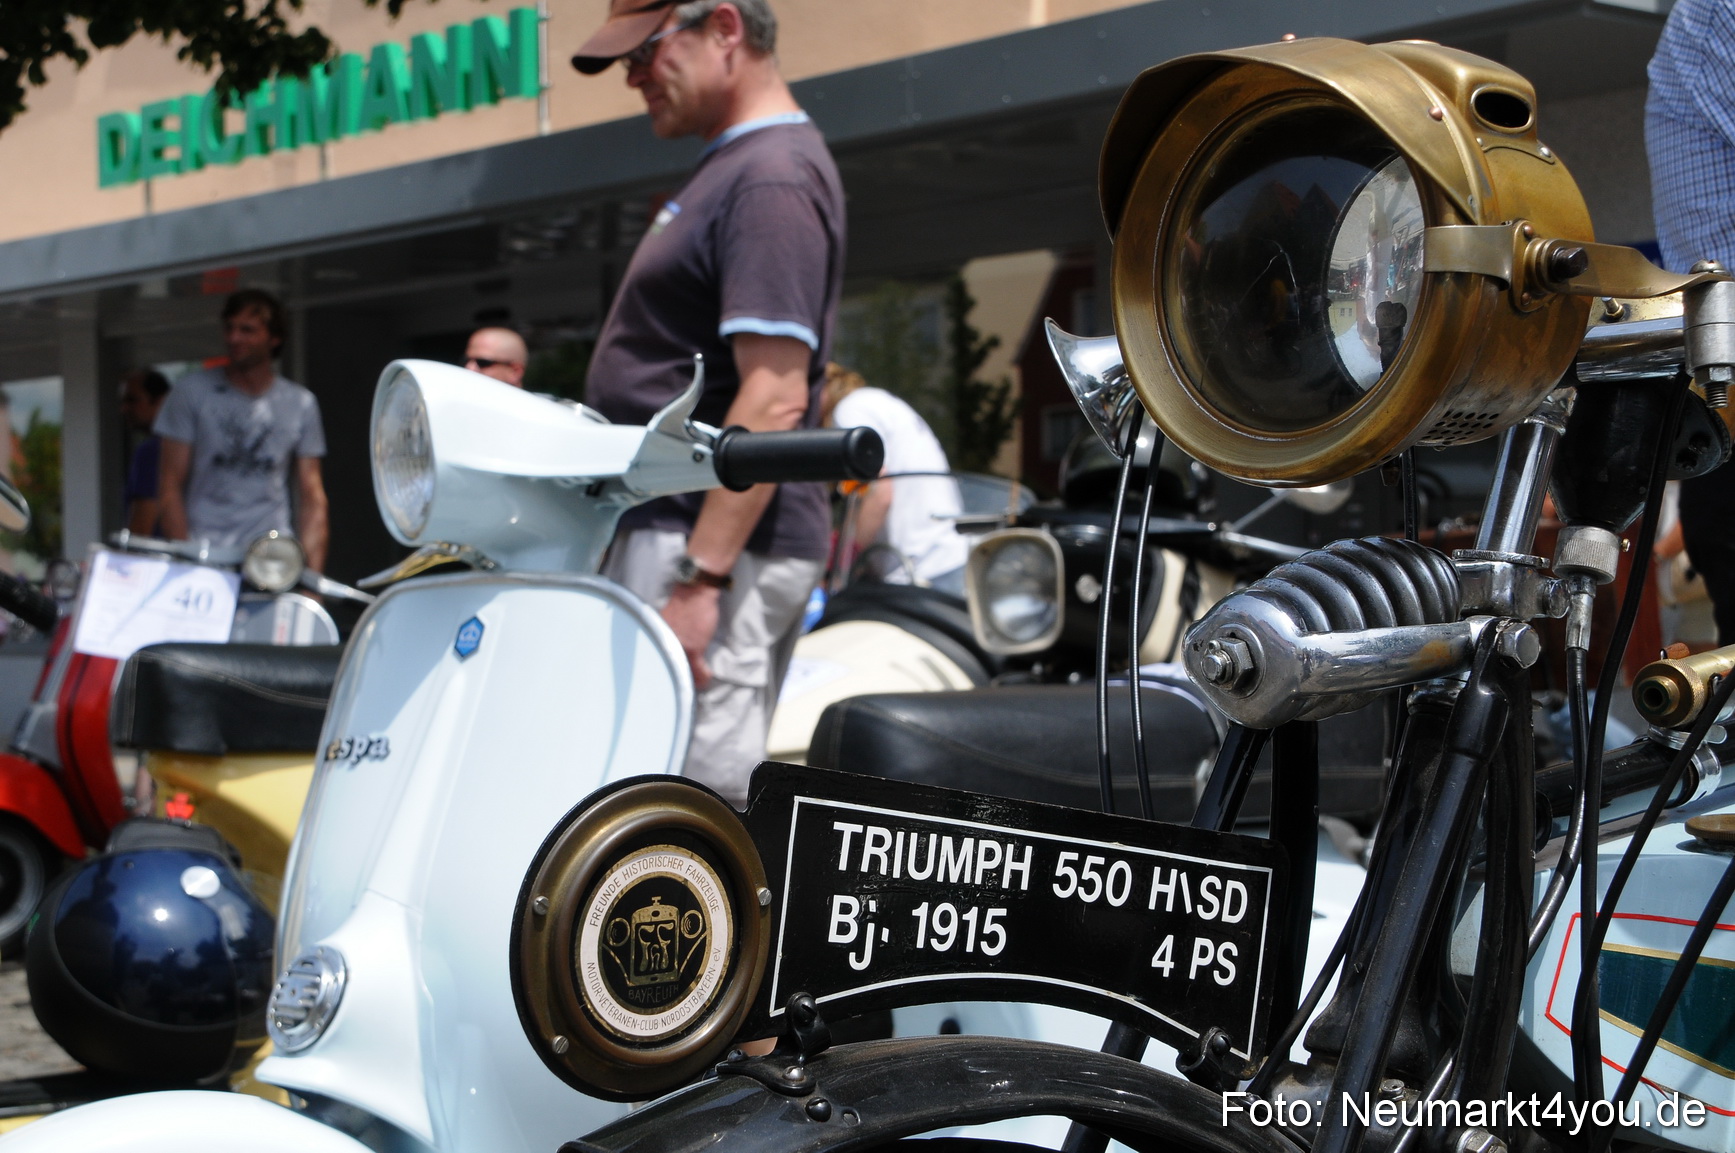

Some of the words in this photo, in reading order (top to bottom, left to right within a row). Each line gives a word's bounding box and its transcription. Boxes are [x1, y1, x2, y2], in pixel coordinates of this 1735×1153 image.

[98, 7, 540, 189] DEICHMANN
[174, 586, 214, 615] 40
[325, 736, 391, 771] espa
[589, 877, 622, 927] FREUNDE
[622, 856, 684, 881] HISTORISCHER
[685, 864, 720, 914] FAHRZEUGE
[833, 821, 1033, 891] TRIUMPH
[1052, 852, 1132, 907] 550
[1148, 866, 1248, 923] H\SD
[911, 902, 1008, 956] 1915
[1151, 934, 1175, 978] 4
[1189, 937, 1239, 986] PS
[628, 984, 679, 1003] BAYREUTH
